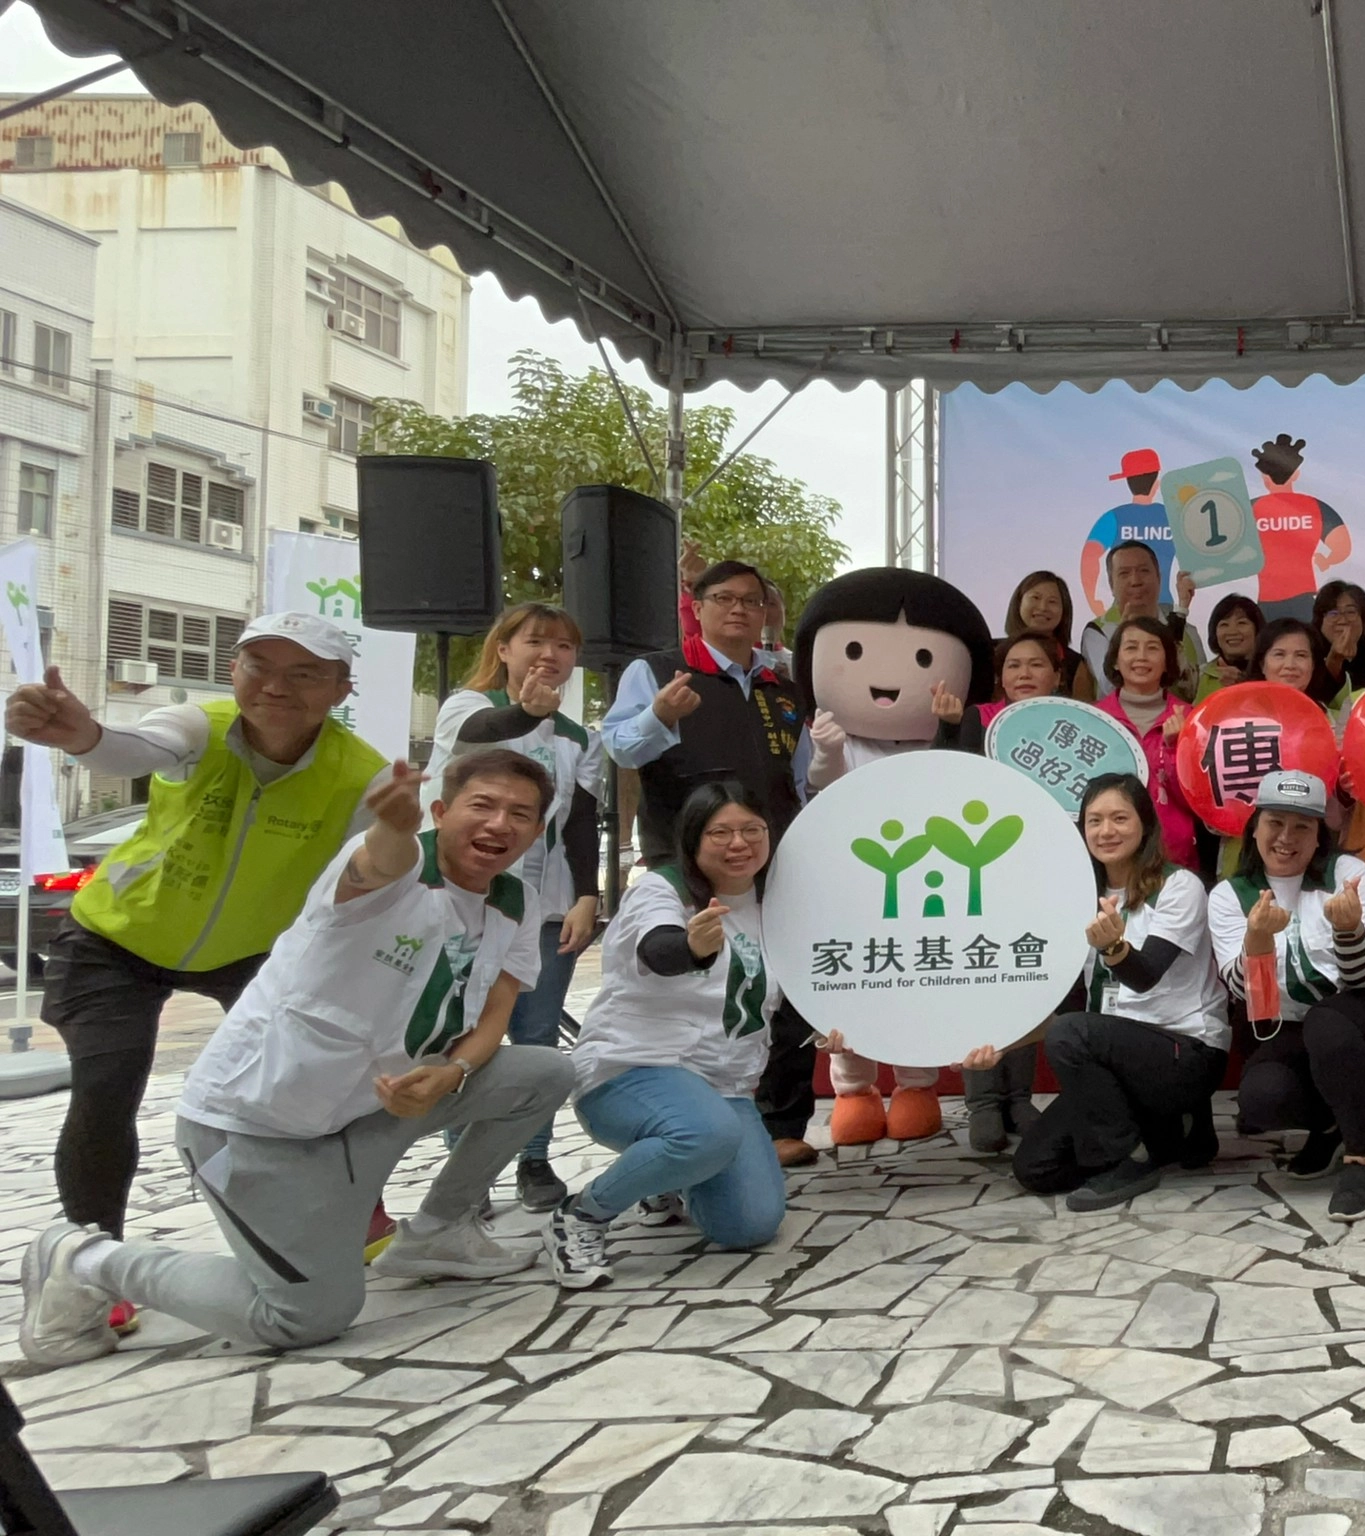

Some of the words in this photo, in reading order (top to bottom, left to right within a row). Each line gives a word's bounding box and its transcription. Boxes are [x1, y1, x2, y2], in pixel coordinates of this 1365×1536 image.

[1120, 525, 1173, 541] BLIND
[1200, 499, 1228, 547] 1
[1256, 515, 1313, 532] GUIDE
[1047, 719, 1109, 768] 傳愛
[1200, 720, 1282, 809] 傳
[267, 815, 308, 832] Rotary
[811, 931, 1049, 977] 家扶基金會
[811, 980, 857, 992] Taiwan
[861, 978, 893, 990] Fund
[897, 976, 915, 988] for
[919, 975, 971, 987] Children
[974, 973, 997, 985] and
[1001, 971, 1049, 983] Families
